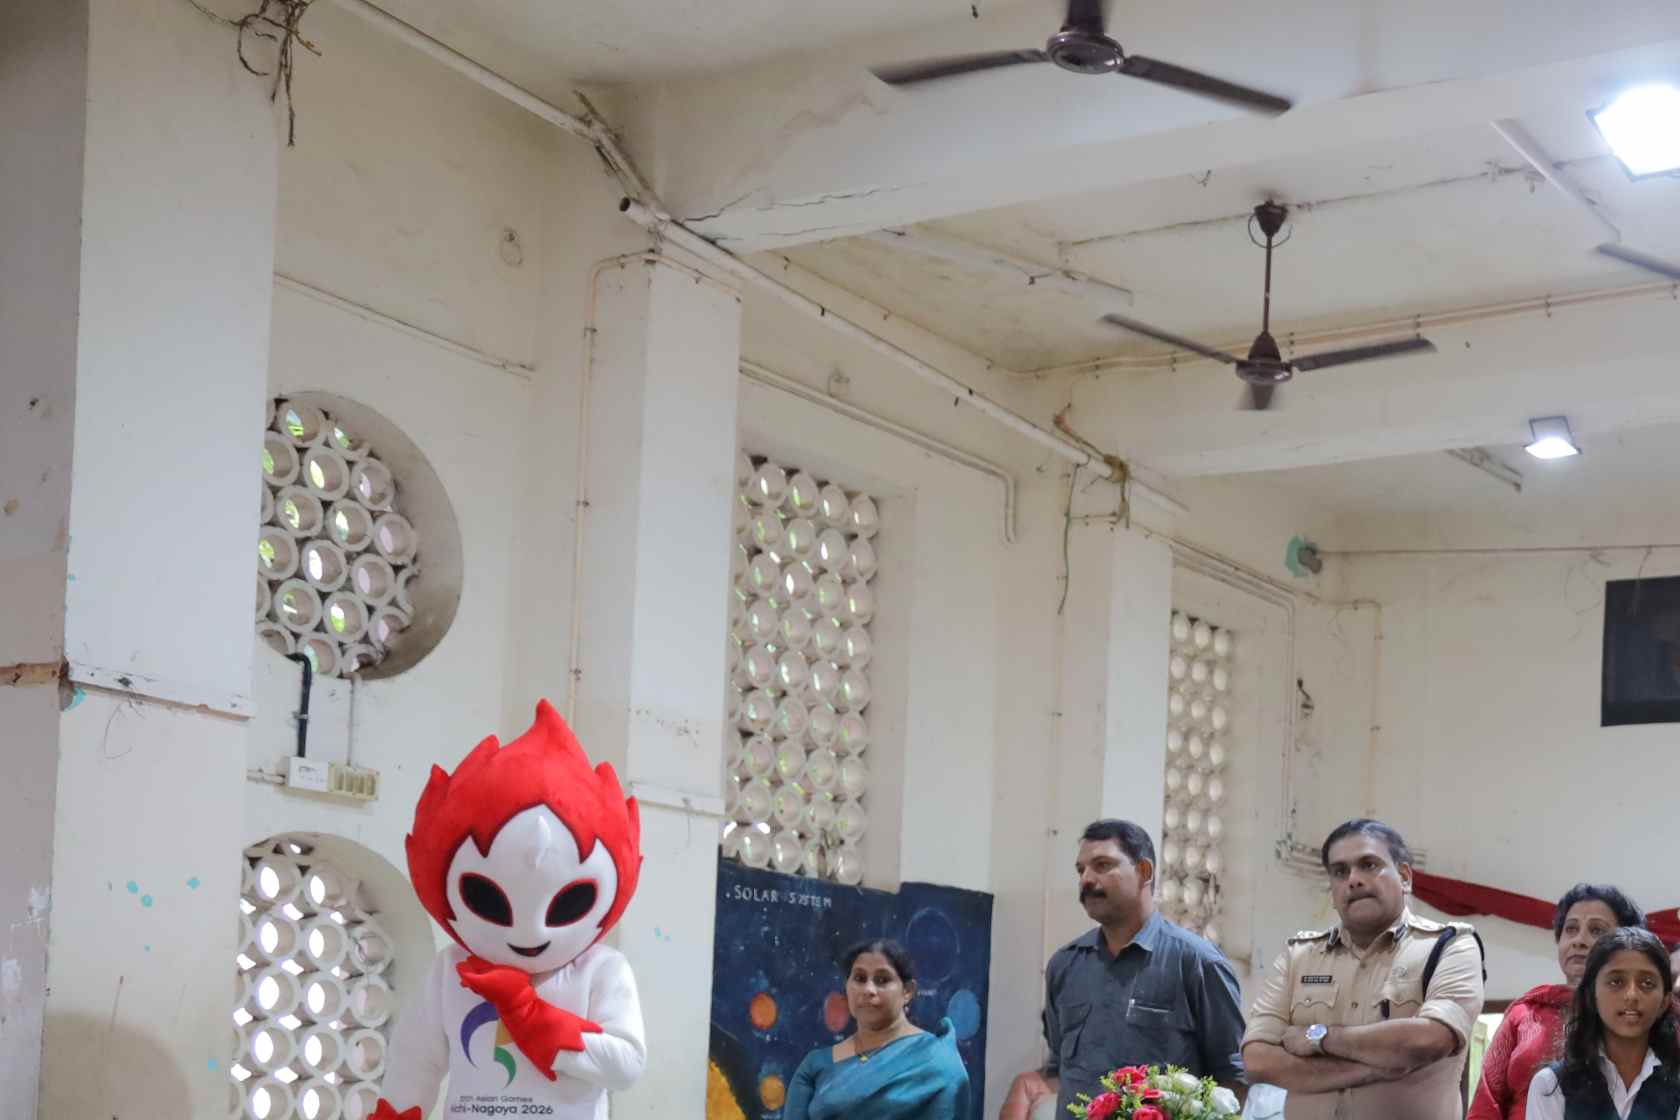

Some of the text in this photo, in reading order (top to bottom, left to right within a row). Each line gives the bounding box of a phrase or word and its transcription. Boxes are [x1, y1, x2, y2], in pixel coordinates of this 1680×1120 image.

[734, 884, 778, 903] SOLAR
[450, 1104, 554, 1116] ichi-Nagoya 2026
